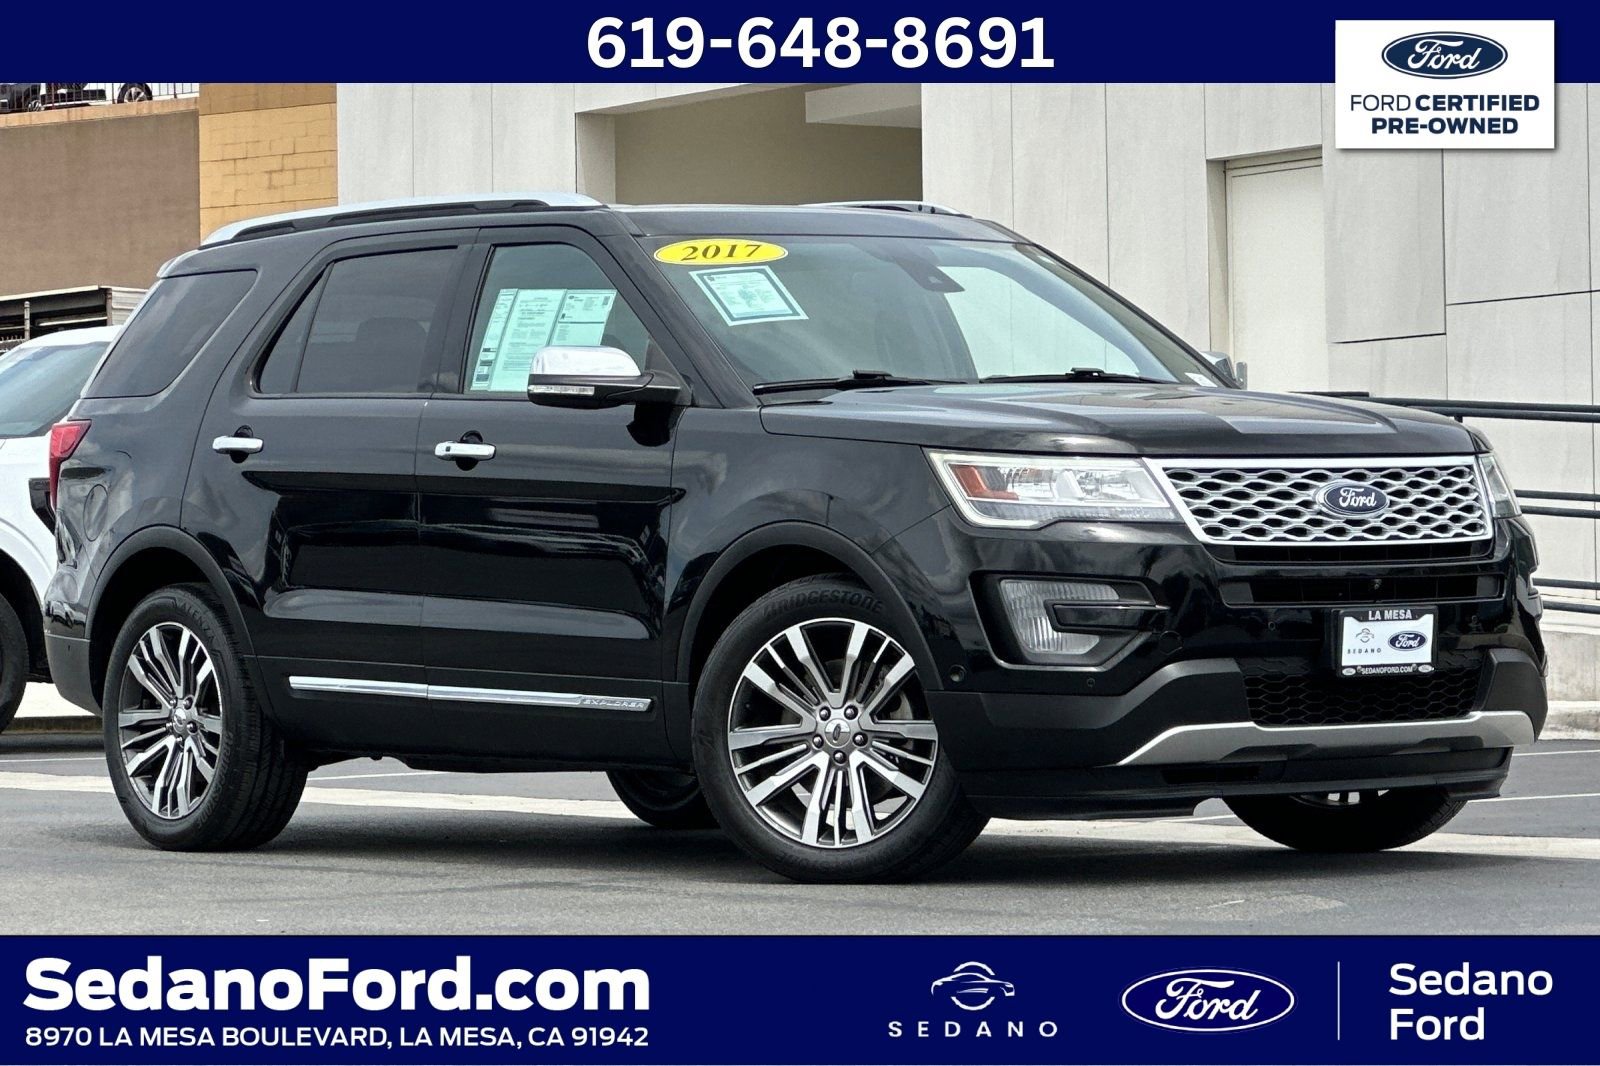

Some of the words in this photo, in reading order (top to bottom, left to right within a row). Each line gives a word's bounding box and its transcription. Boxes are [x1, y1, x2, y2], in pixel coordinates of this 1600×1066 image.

[681, 243, 762, 261] 2017
[1338, 487, 1377, 508] Ford
[763, 588, 884, 617] BRIDGESTONE
[1368, 610, 1381, 621] LA
[1384, 609, 1412, 620] MESA
[1395, 633, 1421, 648] Ford
[1347, 647, 1382, 655] SEDANO
[582, 698, 645, 708] EXPLORER
